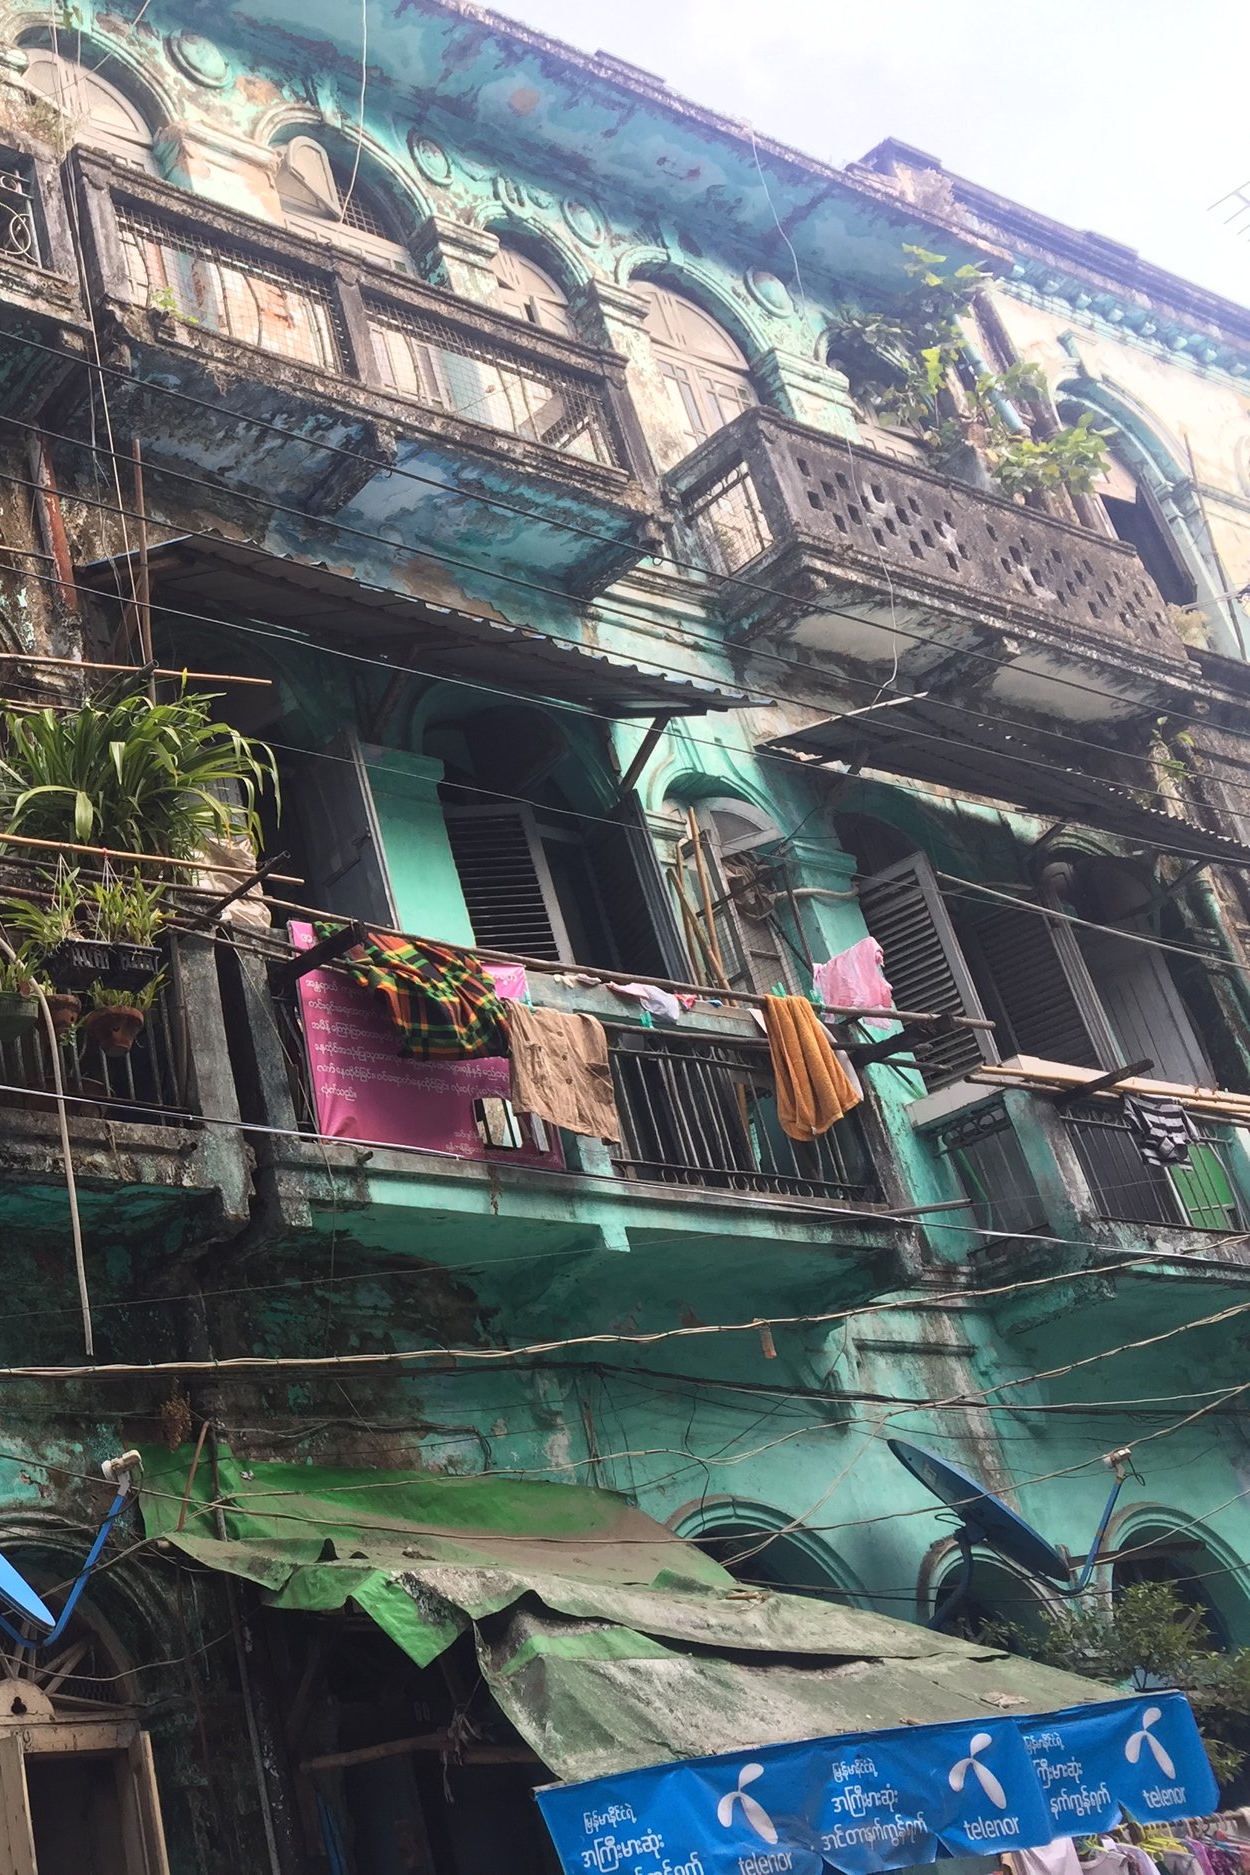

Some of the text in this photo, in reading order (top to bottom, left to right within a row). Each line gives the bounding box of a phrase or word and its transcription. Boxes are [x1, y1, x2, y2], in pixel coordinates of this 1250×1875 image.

[1142, 1785, 1188, 1809] telenor
[963, 1815, 1021, 1840] telenor
[738, 1851, 794, 1875] telenor
